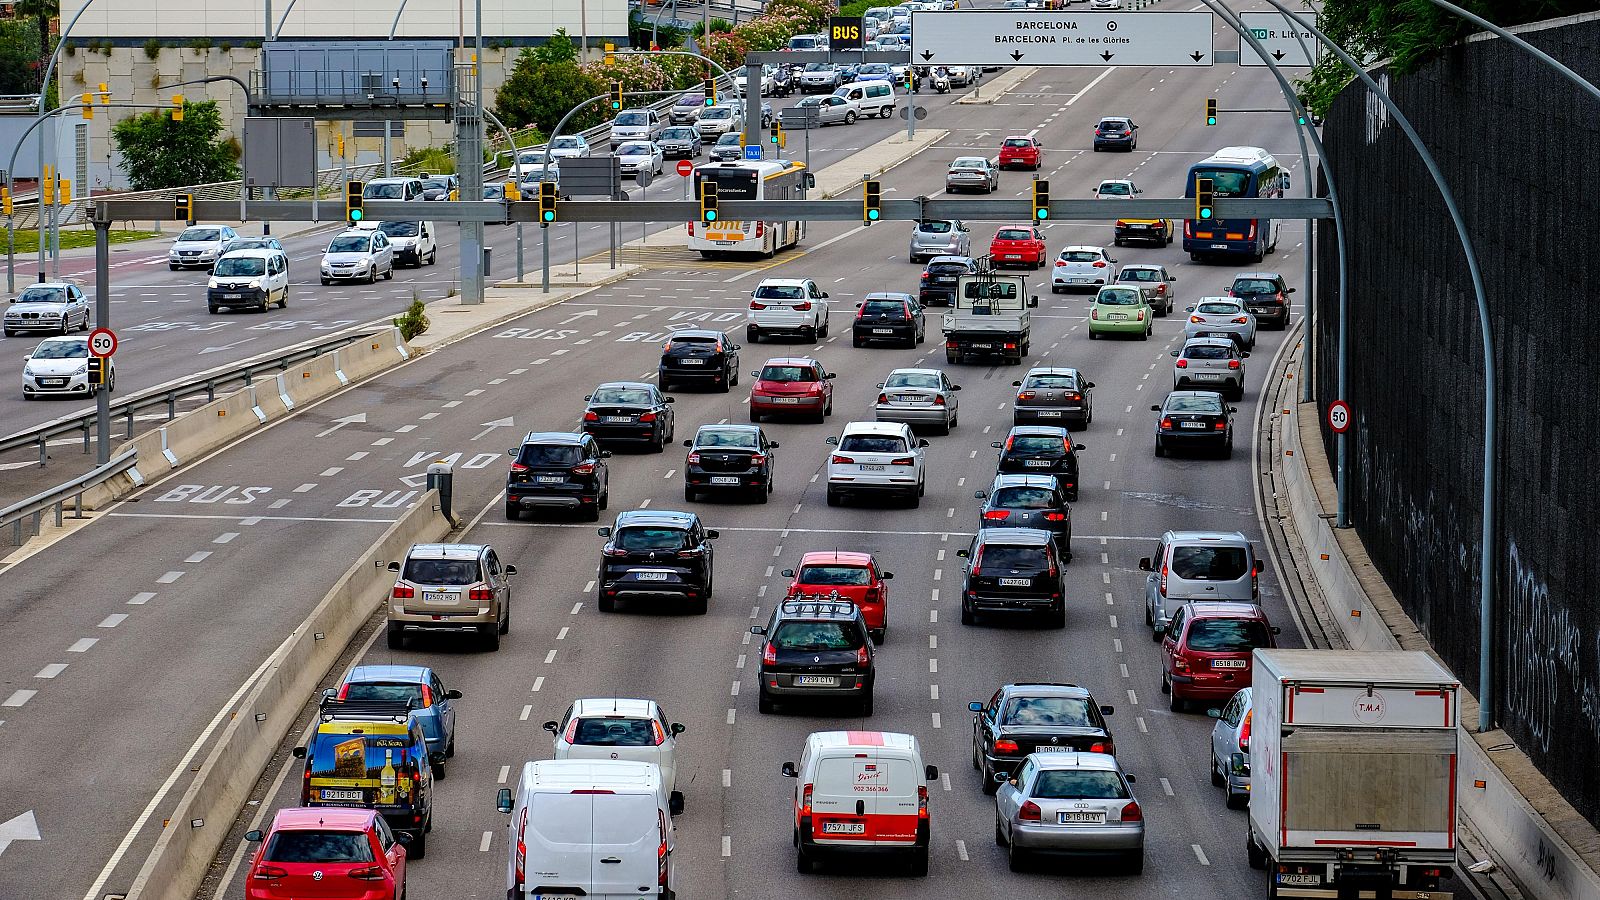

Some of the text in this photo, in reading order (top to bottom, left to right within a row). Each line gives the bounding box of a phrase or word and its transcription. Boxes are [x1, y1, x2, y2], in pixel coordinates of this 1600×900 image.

[1015, 21, 1078, 30] BARCELONA
[833, 26, 859, 40] BUS
[1269, 31, 1278, 39] R.
[994, 35, 1056, 43] BARCELONA
[1102, 36, 1130, 44] Glòries
[492, 327, 578, 340] BUS
[615, 332, 673, 343] BU
[94, 338, 111, 349] 50
[1332, 411, 1346, 423] 50
[153, 484, 272, 504] BUS
[335, 489, 417, 508] BU
[326, 790, 361, 799] 9216 BCT
[827, 823, 863, 831] 7571 JFS
[1281, 874, 1318, 883] 7702 FJL
